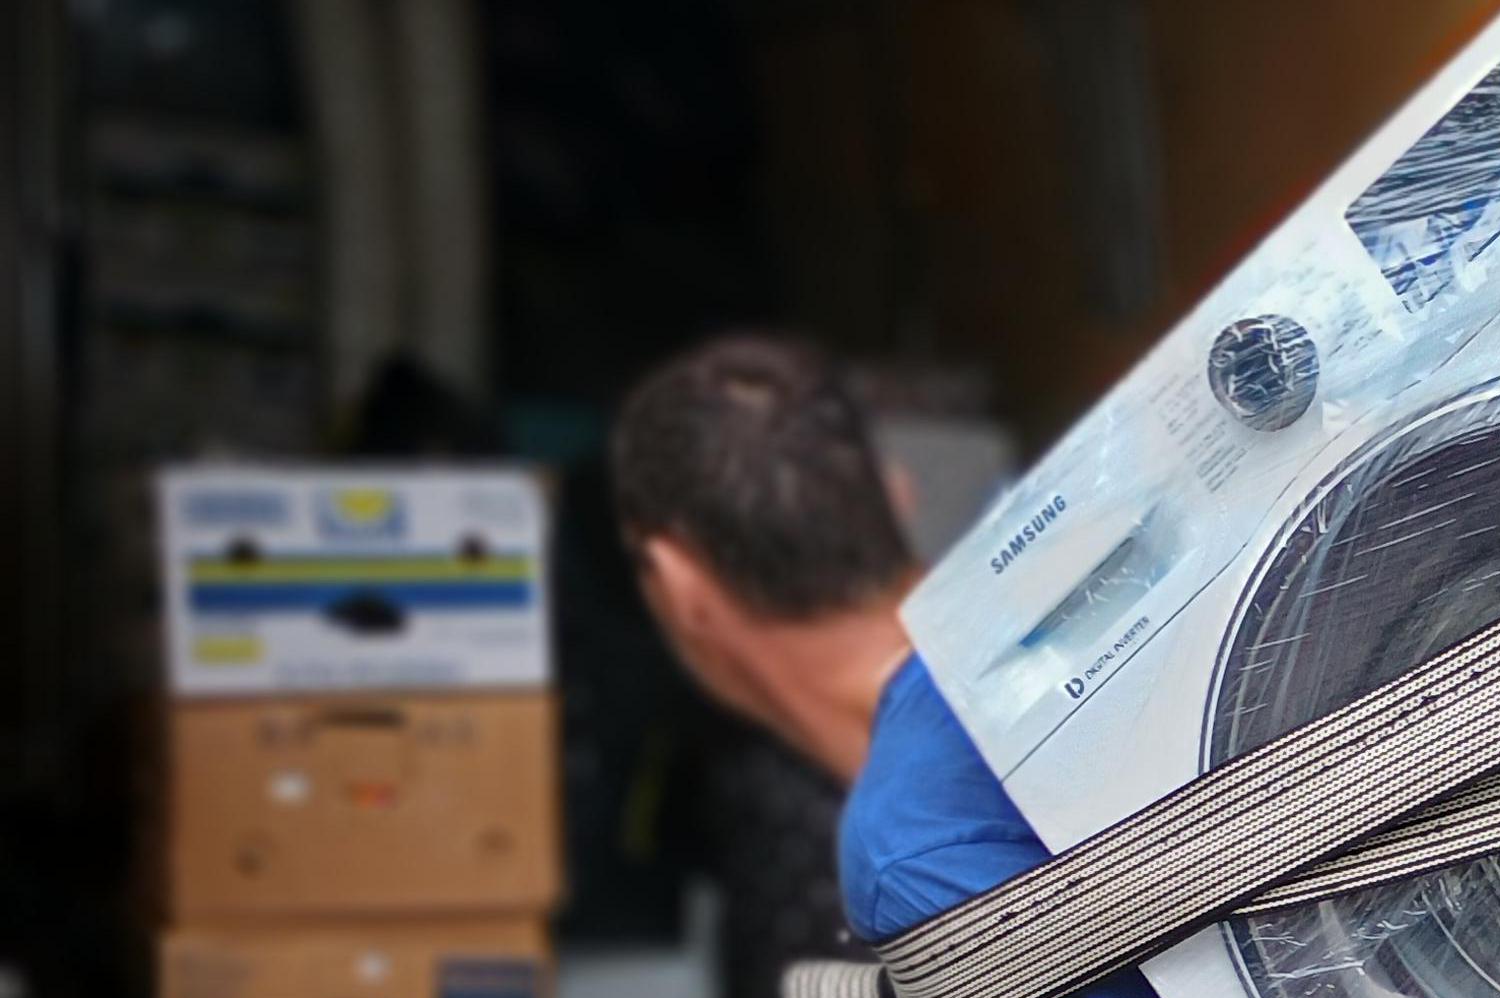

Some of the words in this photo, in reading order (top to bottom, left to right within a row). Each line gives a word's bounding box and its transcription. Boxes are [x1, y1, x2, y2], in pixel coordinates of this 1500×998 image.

[991, 495, 1066, 575] SAMSUNG
[1084, 650, 1115, 680] DIGITAL
[1113, 615, 1150, 653] INVERTER
